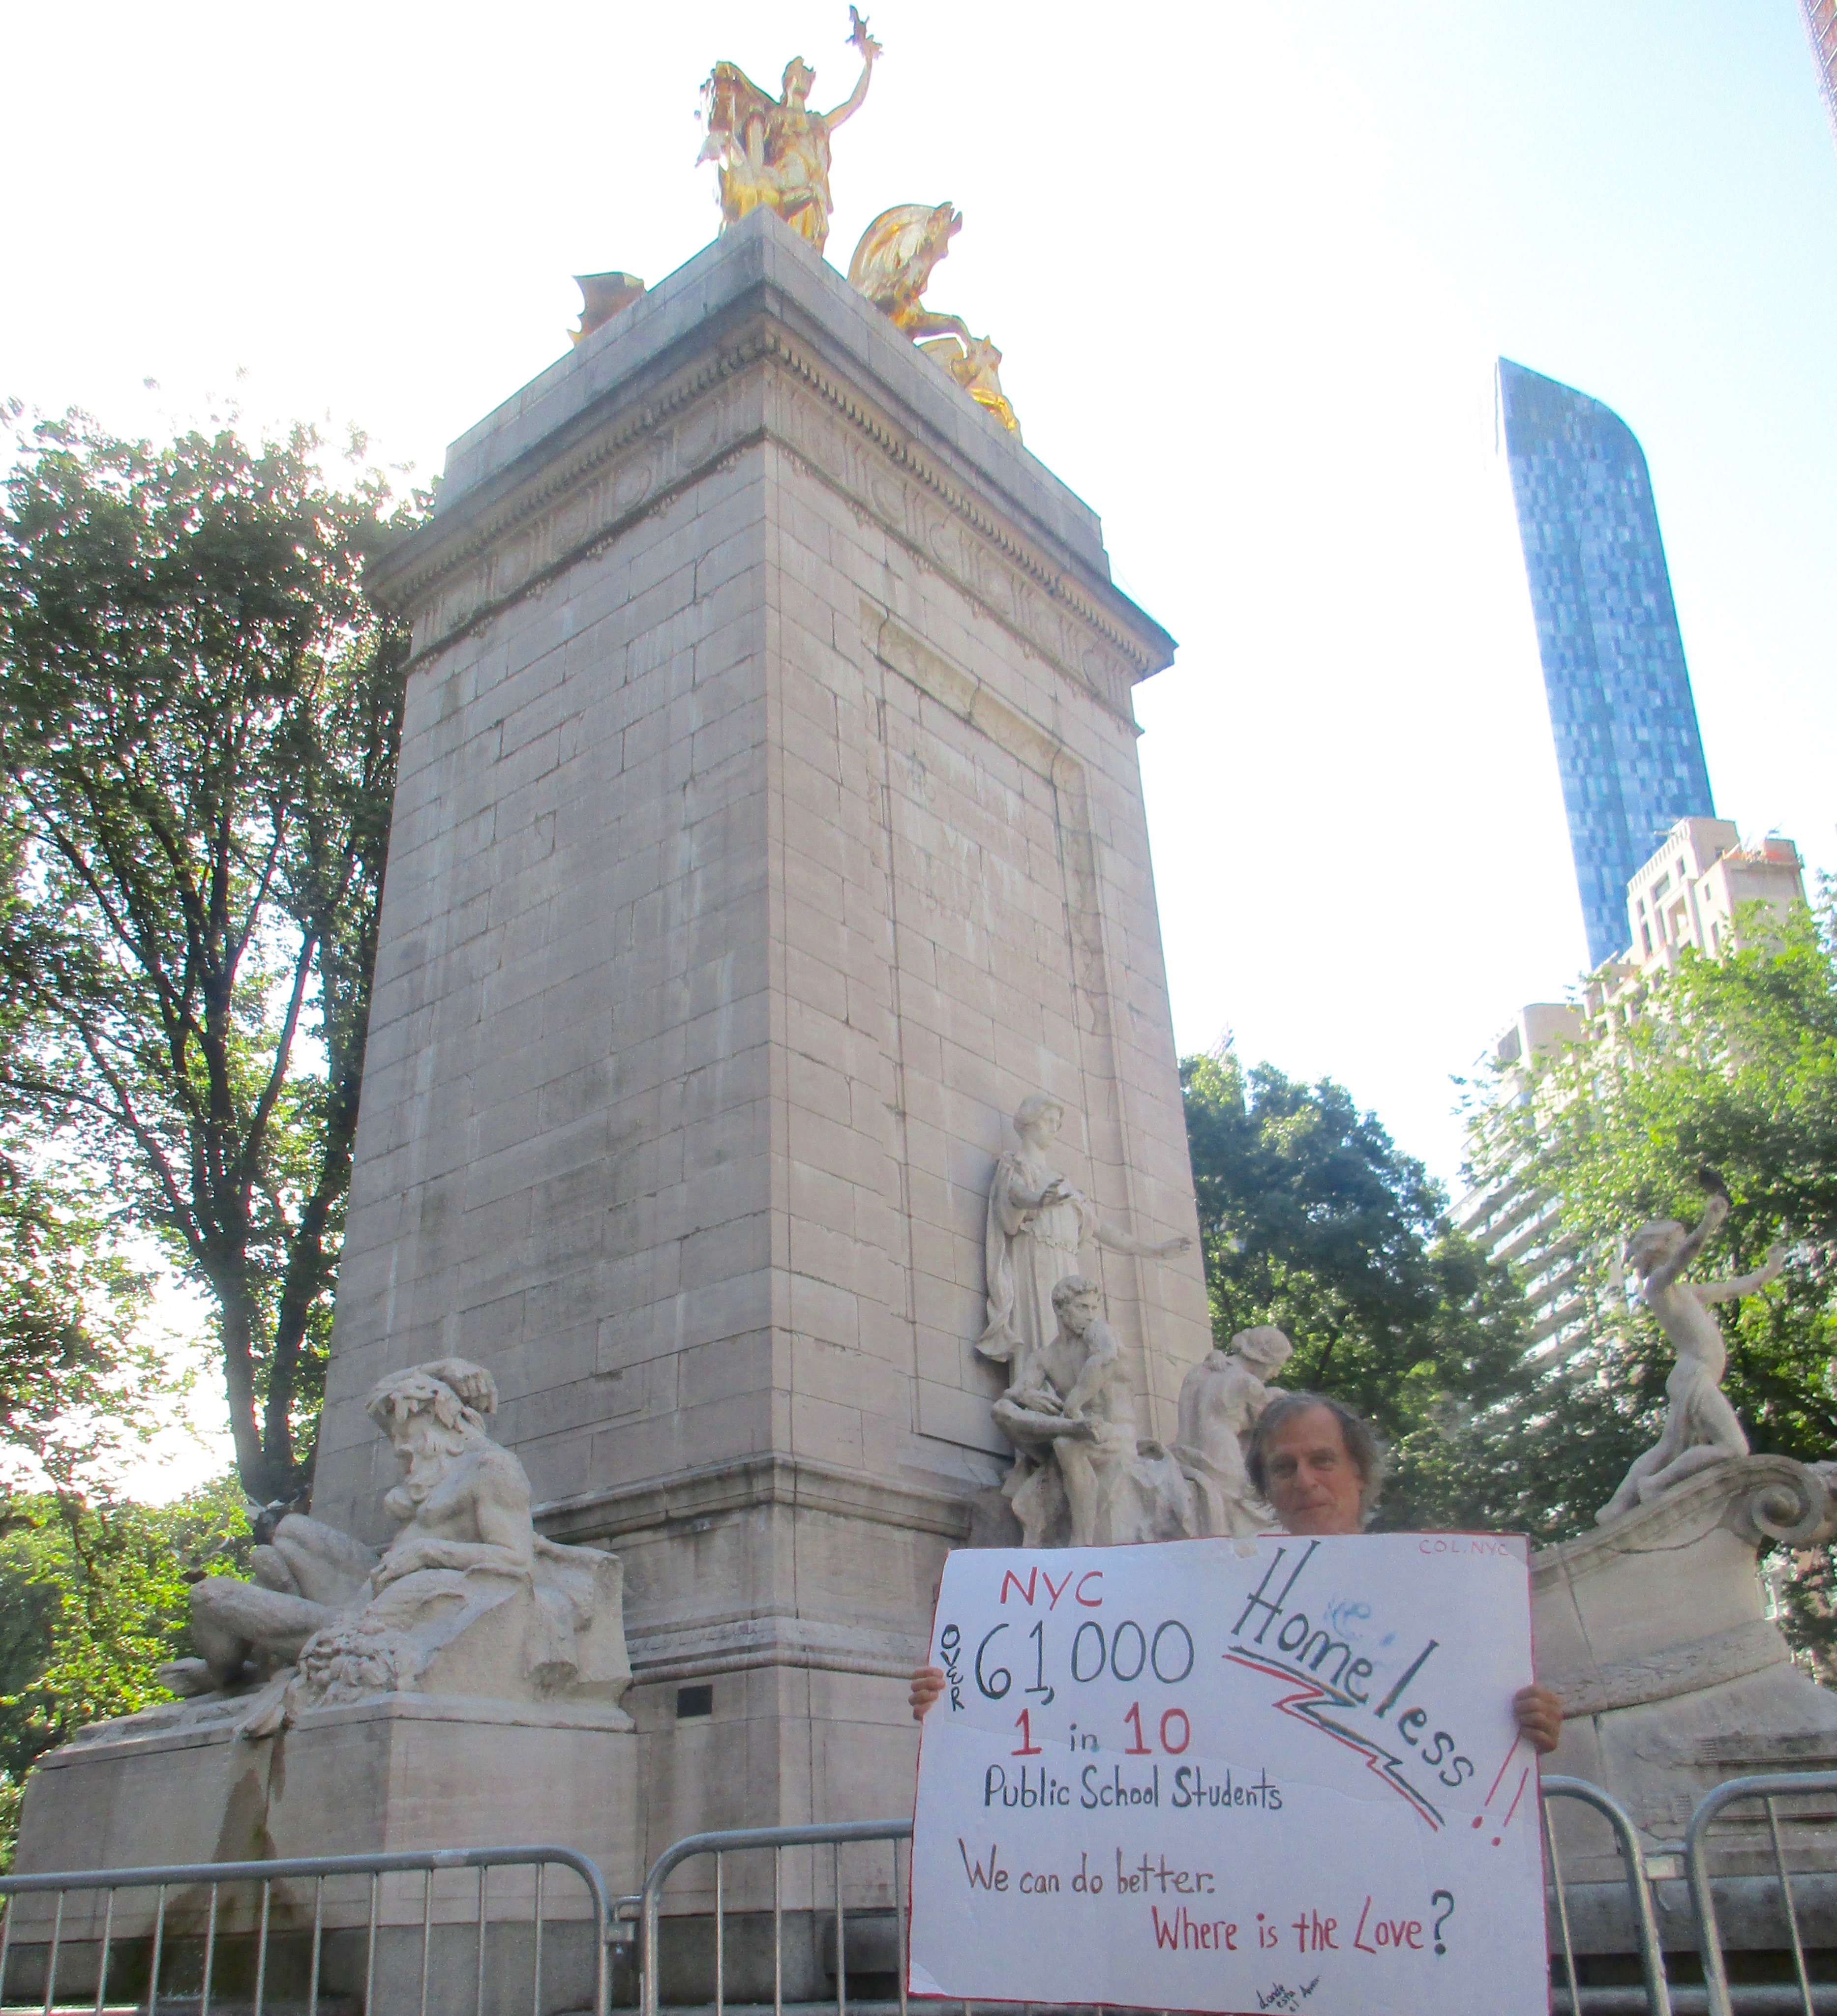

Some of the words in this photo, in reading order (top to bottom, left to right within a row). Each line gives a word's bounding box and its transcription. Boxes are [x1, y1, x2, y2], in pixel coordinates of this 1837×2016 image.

[1000, 1566, 1103, 1611] NYC
[940, 1624, 964, 1712] OVER
[975, 1619, 1195, 1705] 61,000
[1011, 1708, 1043, 1756] 1
[1070, 1722, 1099, 1752] in
[1123, 1701, 1190, 1755] 10
[984, 1764, 1070, 1808] Public
[1081, 1764, 1159, 1809] School
[1172, 1765, 1283, 1809] Students
[959, 1838, 1009, 1892] We
[1020, 1871, 1060, 1895] can
[1072, 1851, 1103, 1894] do
[1116, 1846, 1215, 1894] better.
[1151, 1905, 1238, 1951] Where
[1257, 1913, 1278, 1949] is
[1291, 1908, 1339, 1953] the
[1354, 1889, 1455, 1955] Love?
